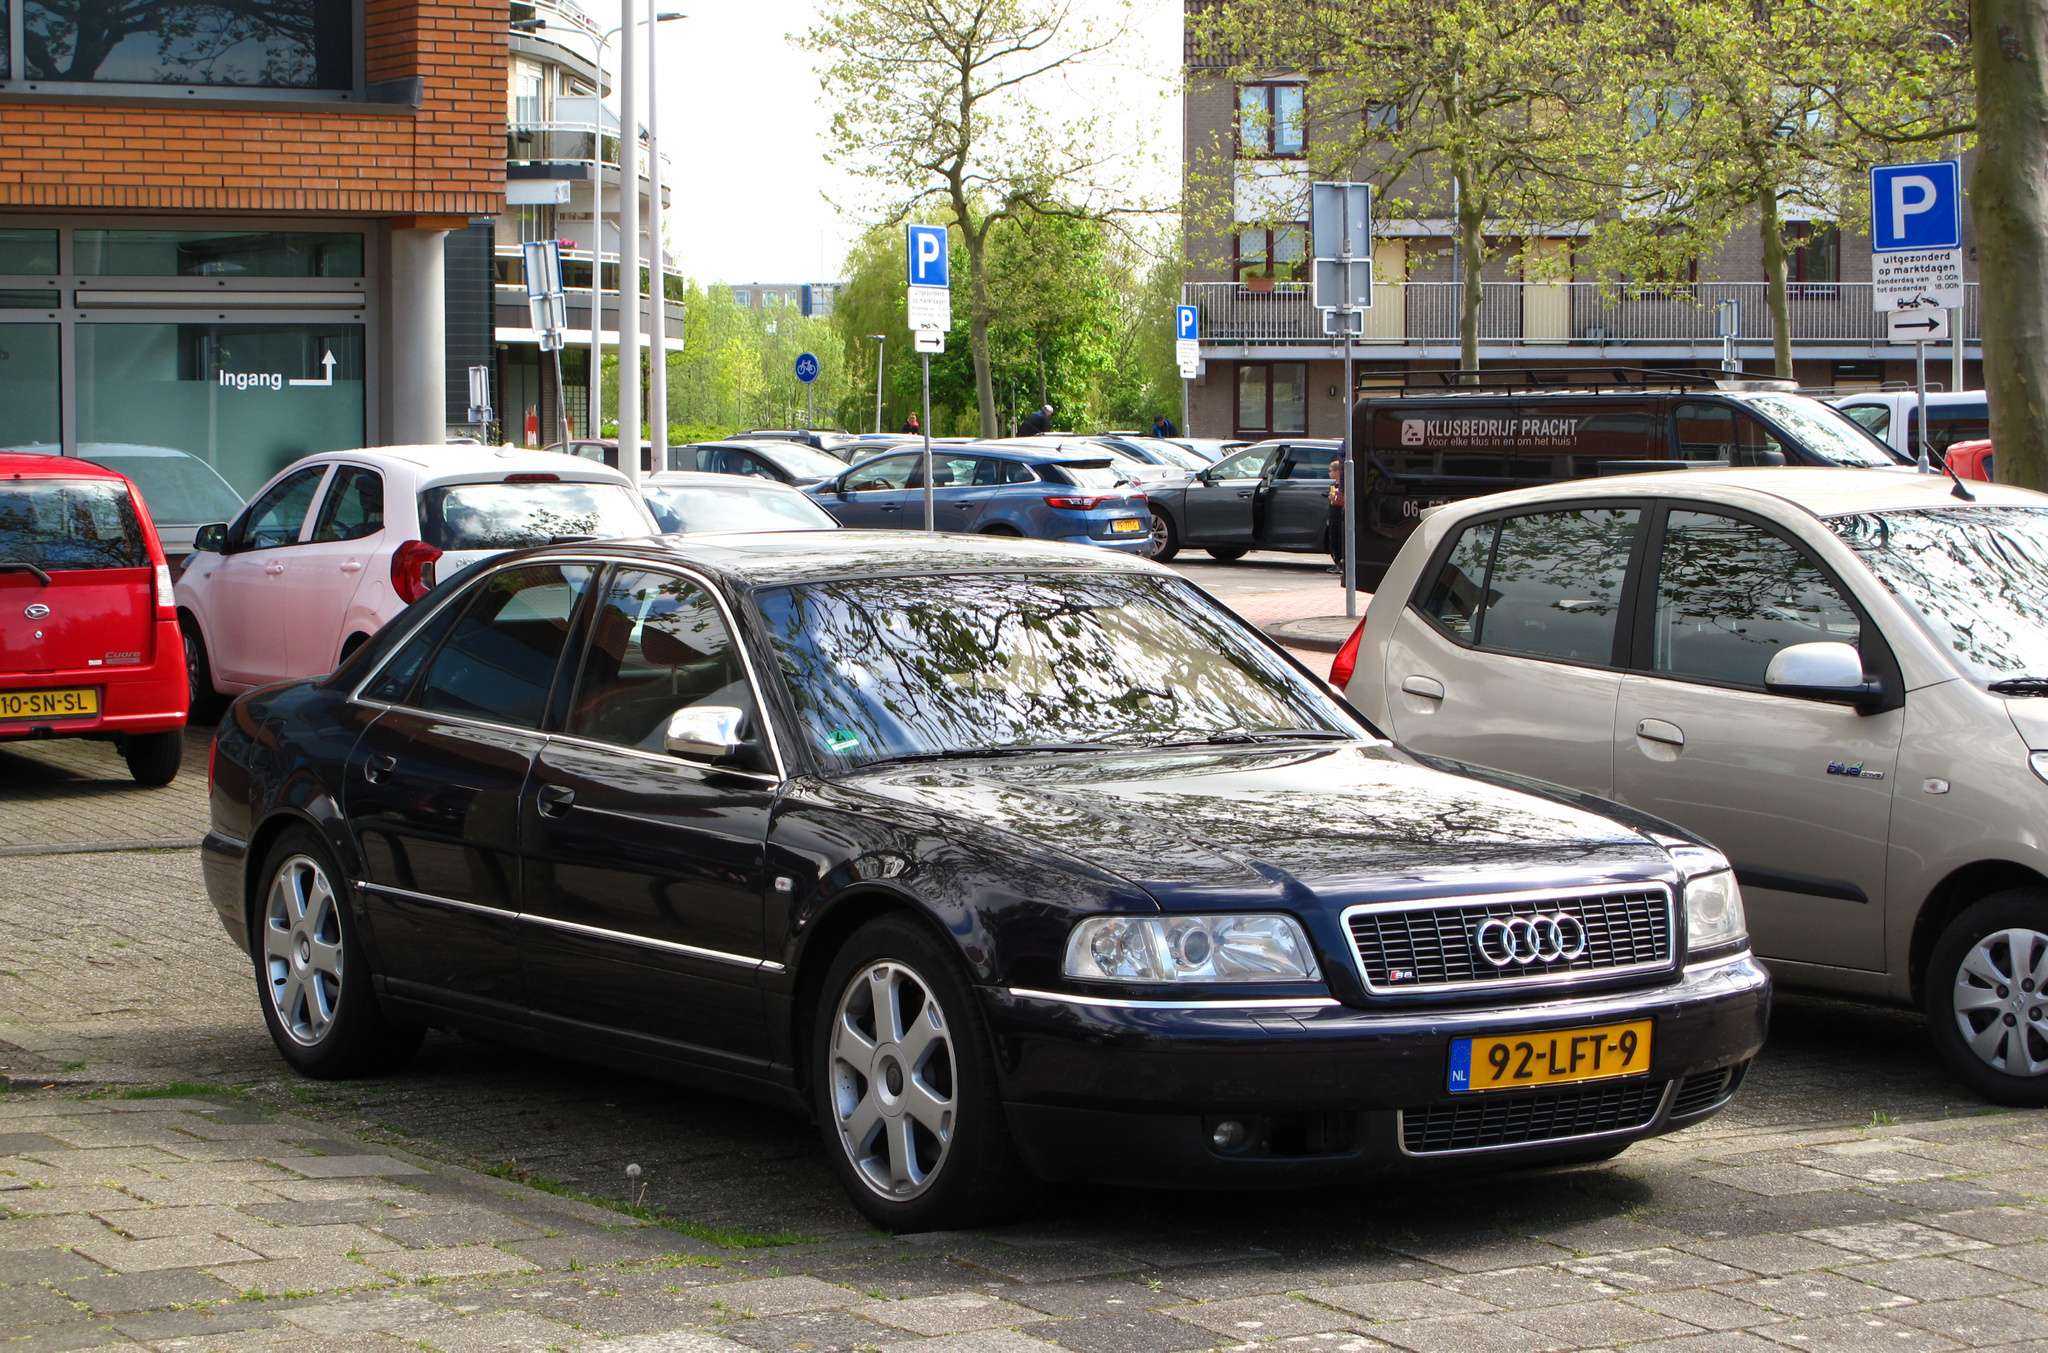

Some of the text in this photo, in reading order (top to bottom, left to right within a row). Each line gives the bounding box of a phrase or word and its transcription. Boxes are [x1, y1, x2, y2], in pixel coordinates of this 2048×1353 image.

[1891, 175, 1937, 239] P
[918, 232, 940, 279] P
[1883, 252, 1951, 264] uitgezonderd
[1893, 264, 1956, 274] marktdagen
[1889, 285, 1927, 293] donderdag
[1181, 309, 1193, 337] P
[219, 369, 282, 391] Ingang
[1426, 419, 1578, 437] KLUSBEDRIJF PRACHT
[1427, 438, 1449, 446] Voor
[1450, 437, 1469, 447] elke
[1471, 437, 1489, 446] klus
[1491, 437, 1501, 446] in
[1502, 438, 1515, 446] en
[1517, 438, 1532, 446] om
[1534, 437, 1550, 446] het
[1551, 437, 1571, 446] huis
[105, 651, 142, 659] Cuore
[2, 693, 88, 714] 10-SN-SL
[1488, 1030, 1638, 1081] 92-LFT-9
[1452, 1070, 1467, 1081] NL
